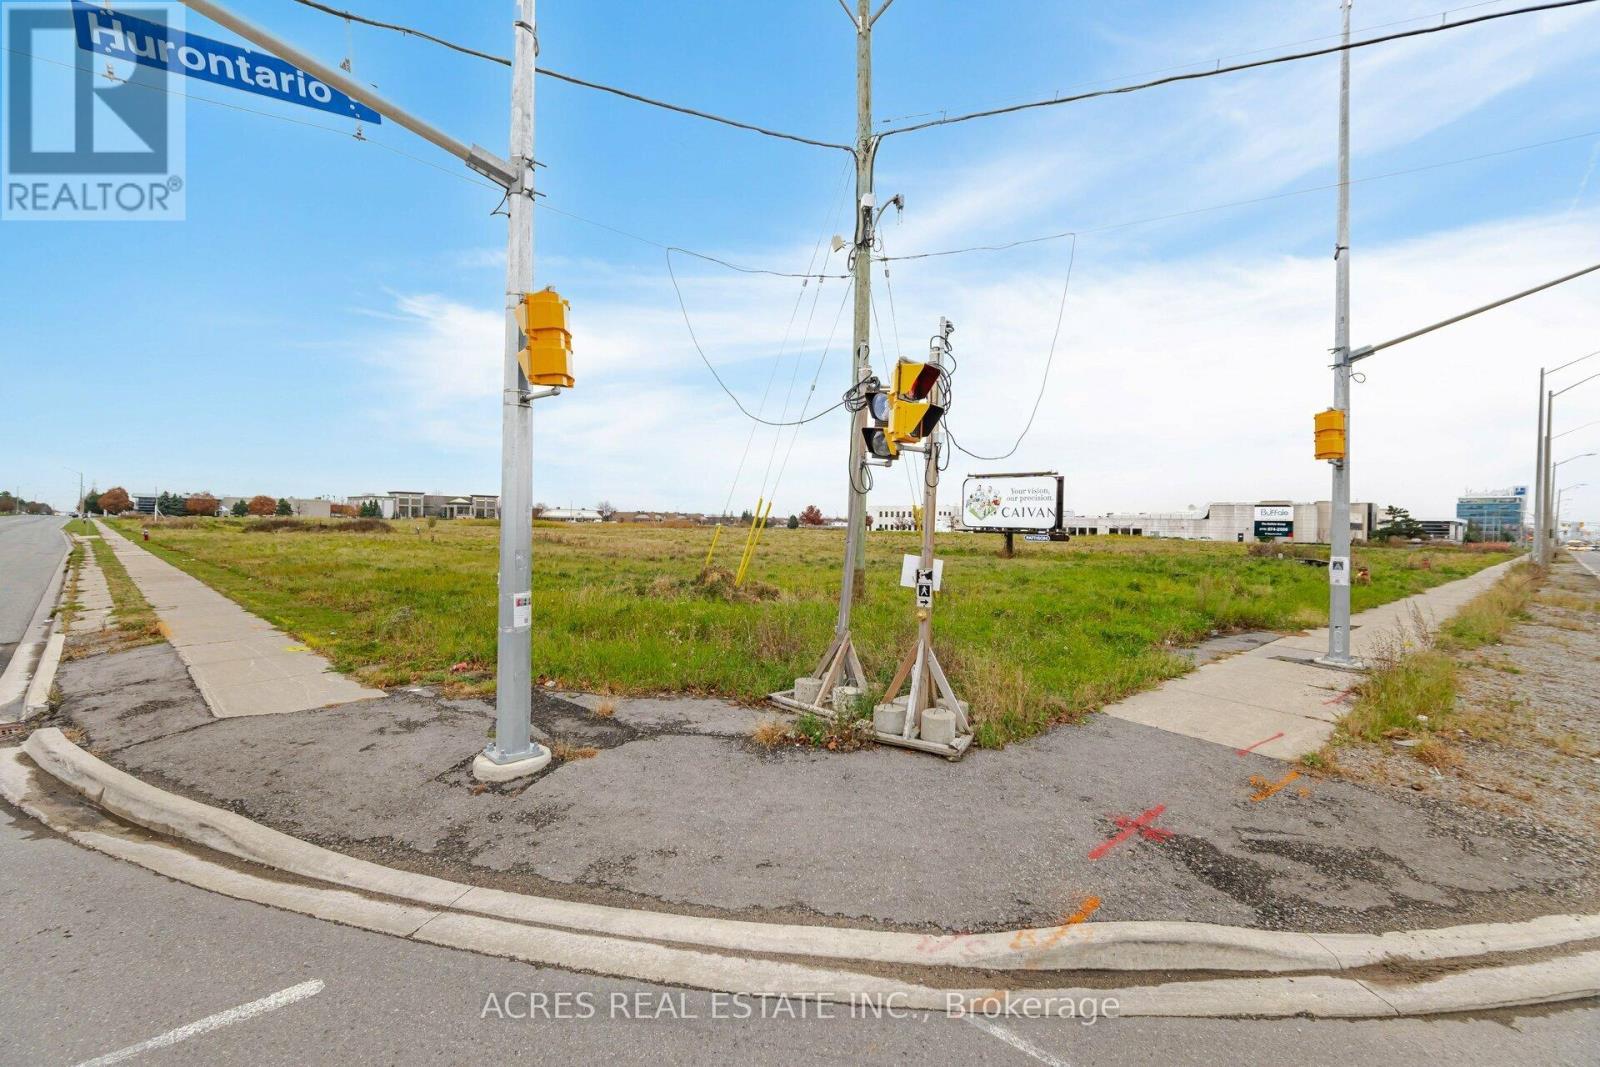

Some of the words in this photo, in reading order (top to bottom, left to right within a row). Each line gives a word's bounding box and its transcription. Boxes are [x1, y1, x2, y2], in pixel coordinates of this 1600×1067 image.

[87, 11, 332, 103] Hurontario
[1010, 487, 1026, 495] Your
[1001, 506, 1056, 518] CAIVAN
